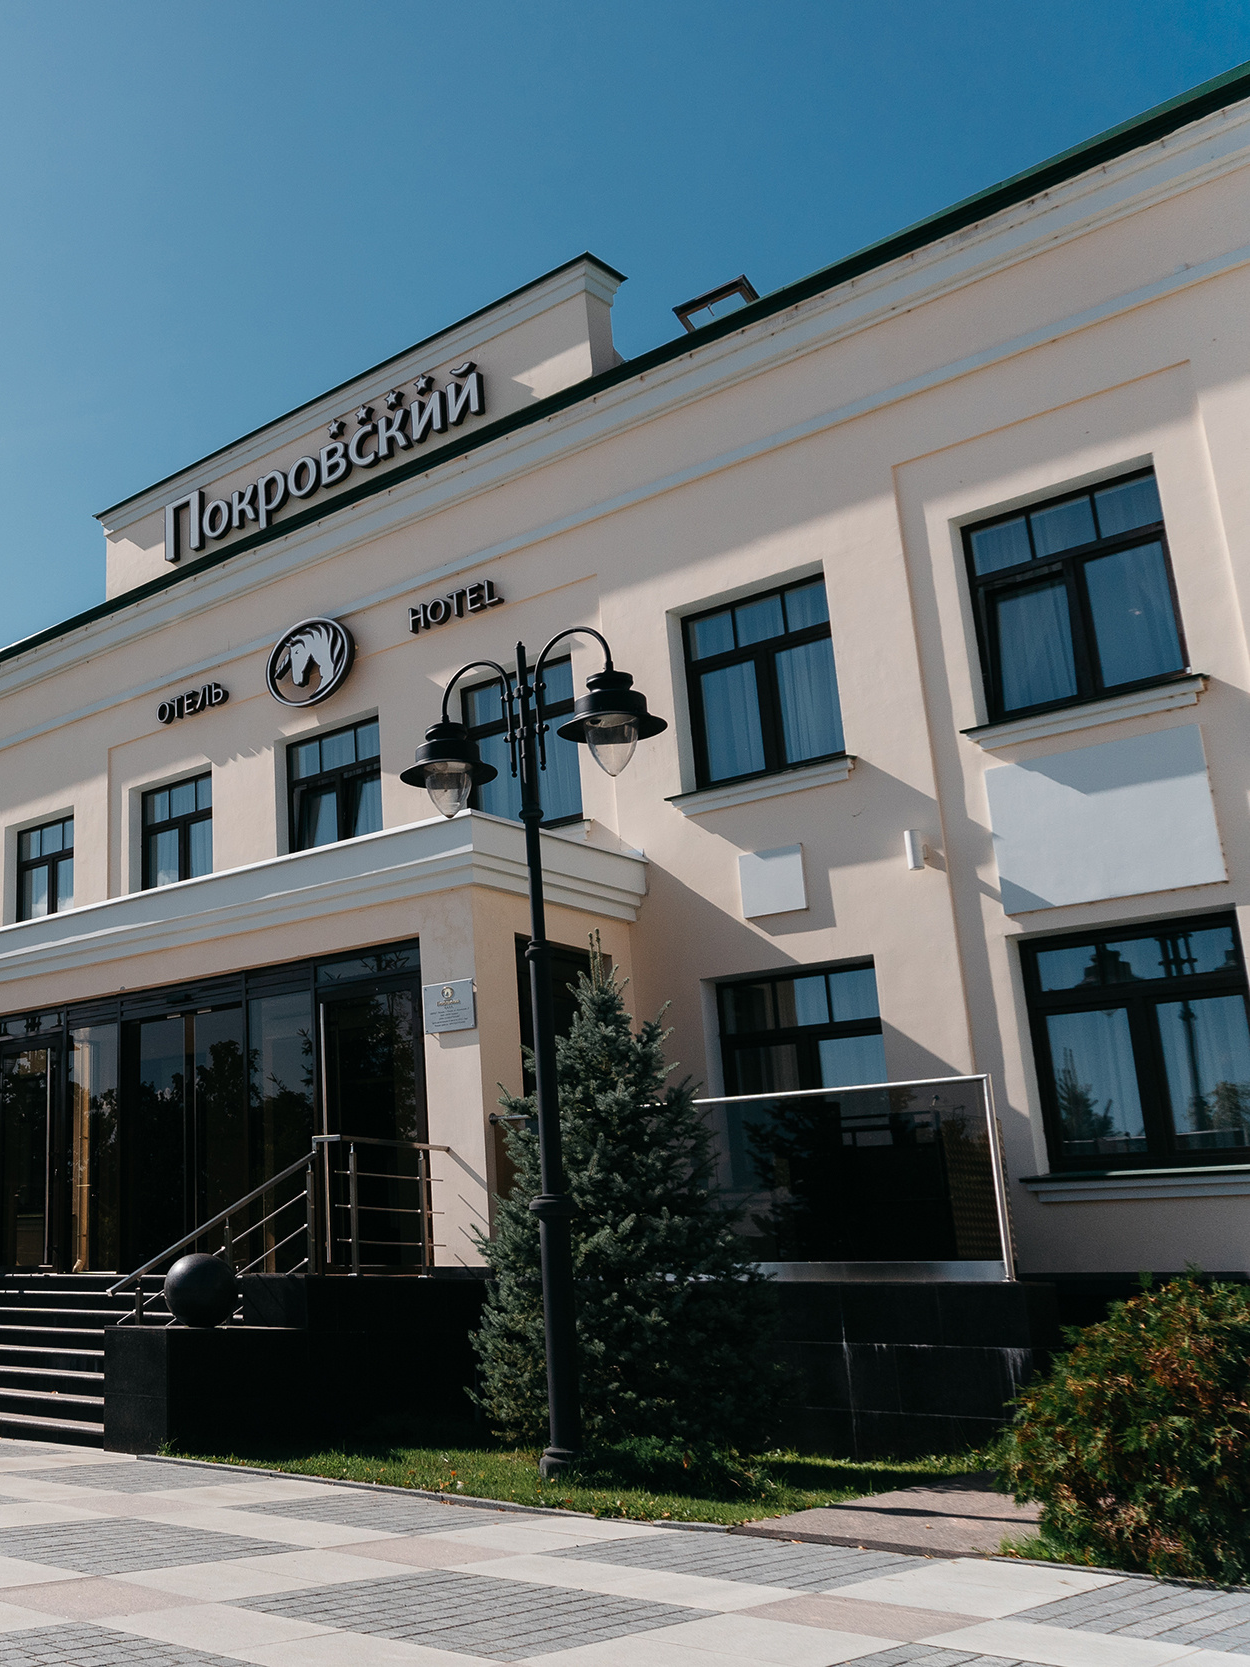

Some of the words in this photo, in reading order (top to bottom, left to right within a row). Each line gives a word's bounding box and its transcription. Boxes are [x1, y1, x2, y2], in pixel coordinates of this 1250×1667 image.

[164, 362, 486, 562] Покровский
[408, 580, 504, 633] HOTEL
[156, 682, 229, 724] ОТЕЛЬ
